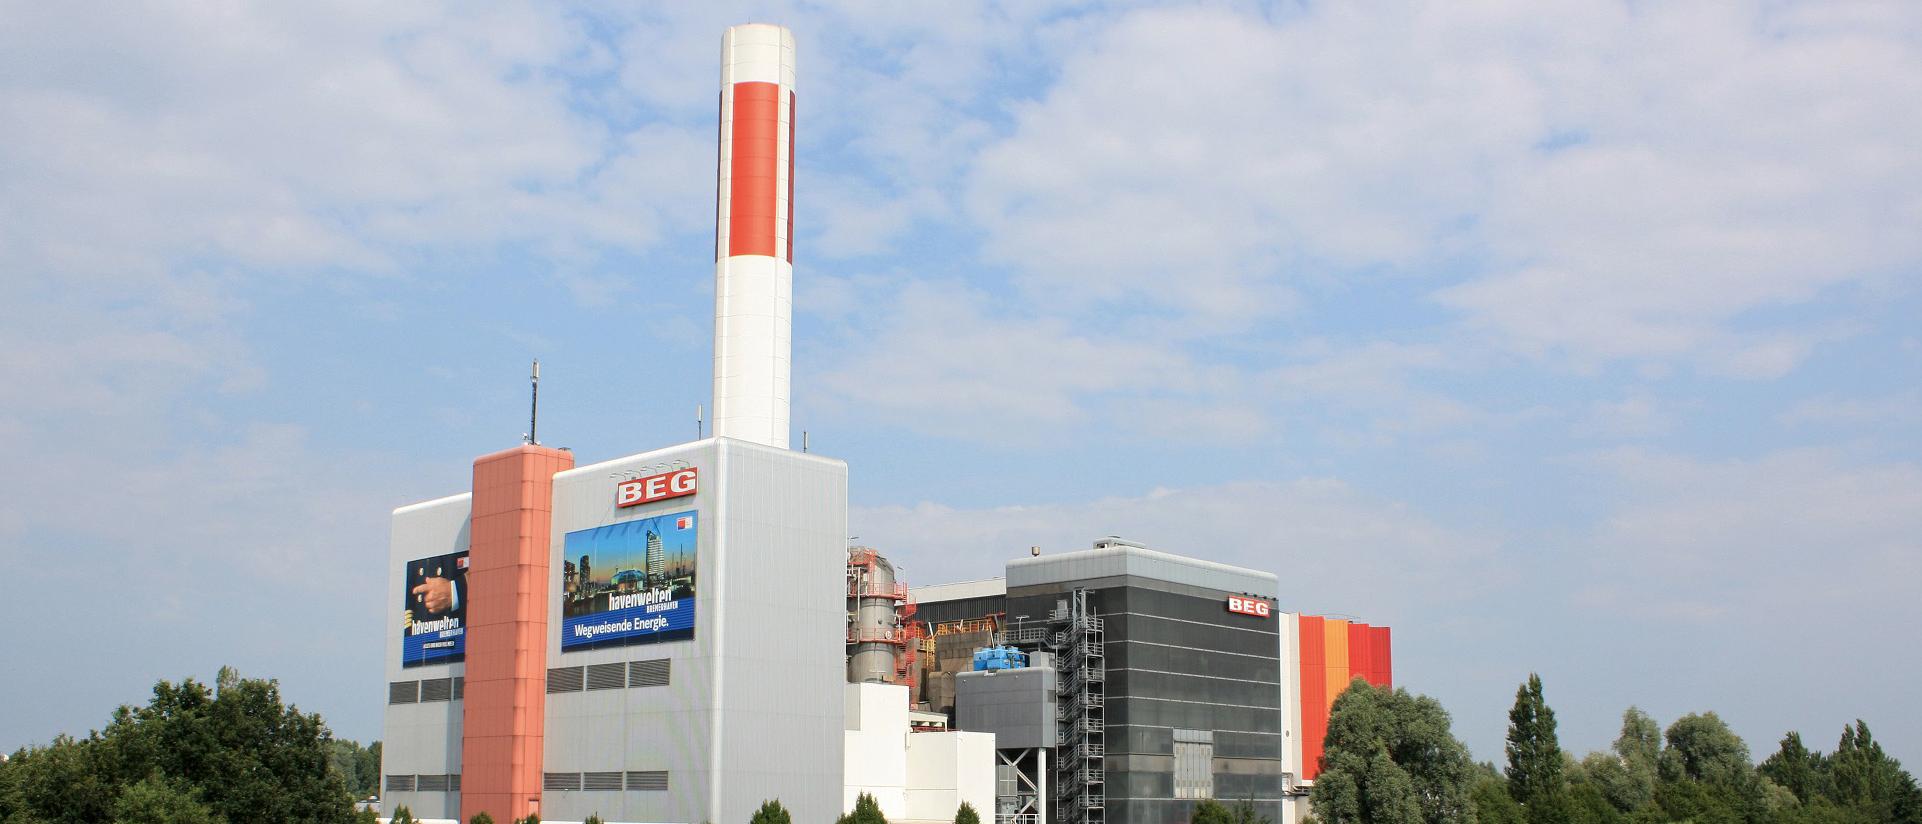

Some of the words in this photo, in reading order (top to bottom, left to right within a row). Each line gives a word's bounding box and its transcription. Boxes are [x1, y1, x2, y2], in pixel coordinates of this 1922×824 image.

[618, 471, 696, 505] BEG
[608, 587, 672, 611] havenwelten
[1229, 598, 1269, 615] BEG
[411, 615, 459, 636] havenwelten
[574, 619, 632, 638] Wegweisende
[634, 615, 669, 631] Energie.
